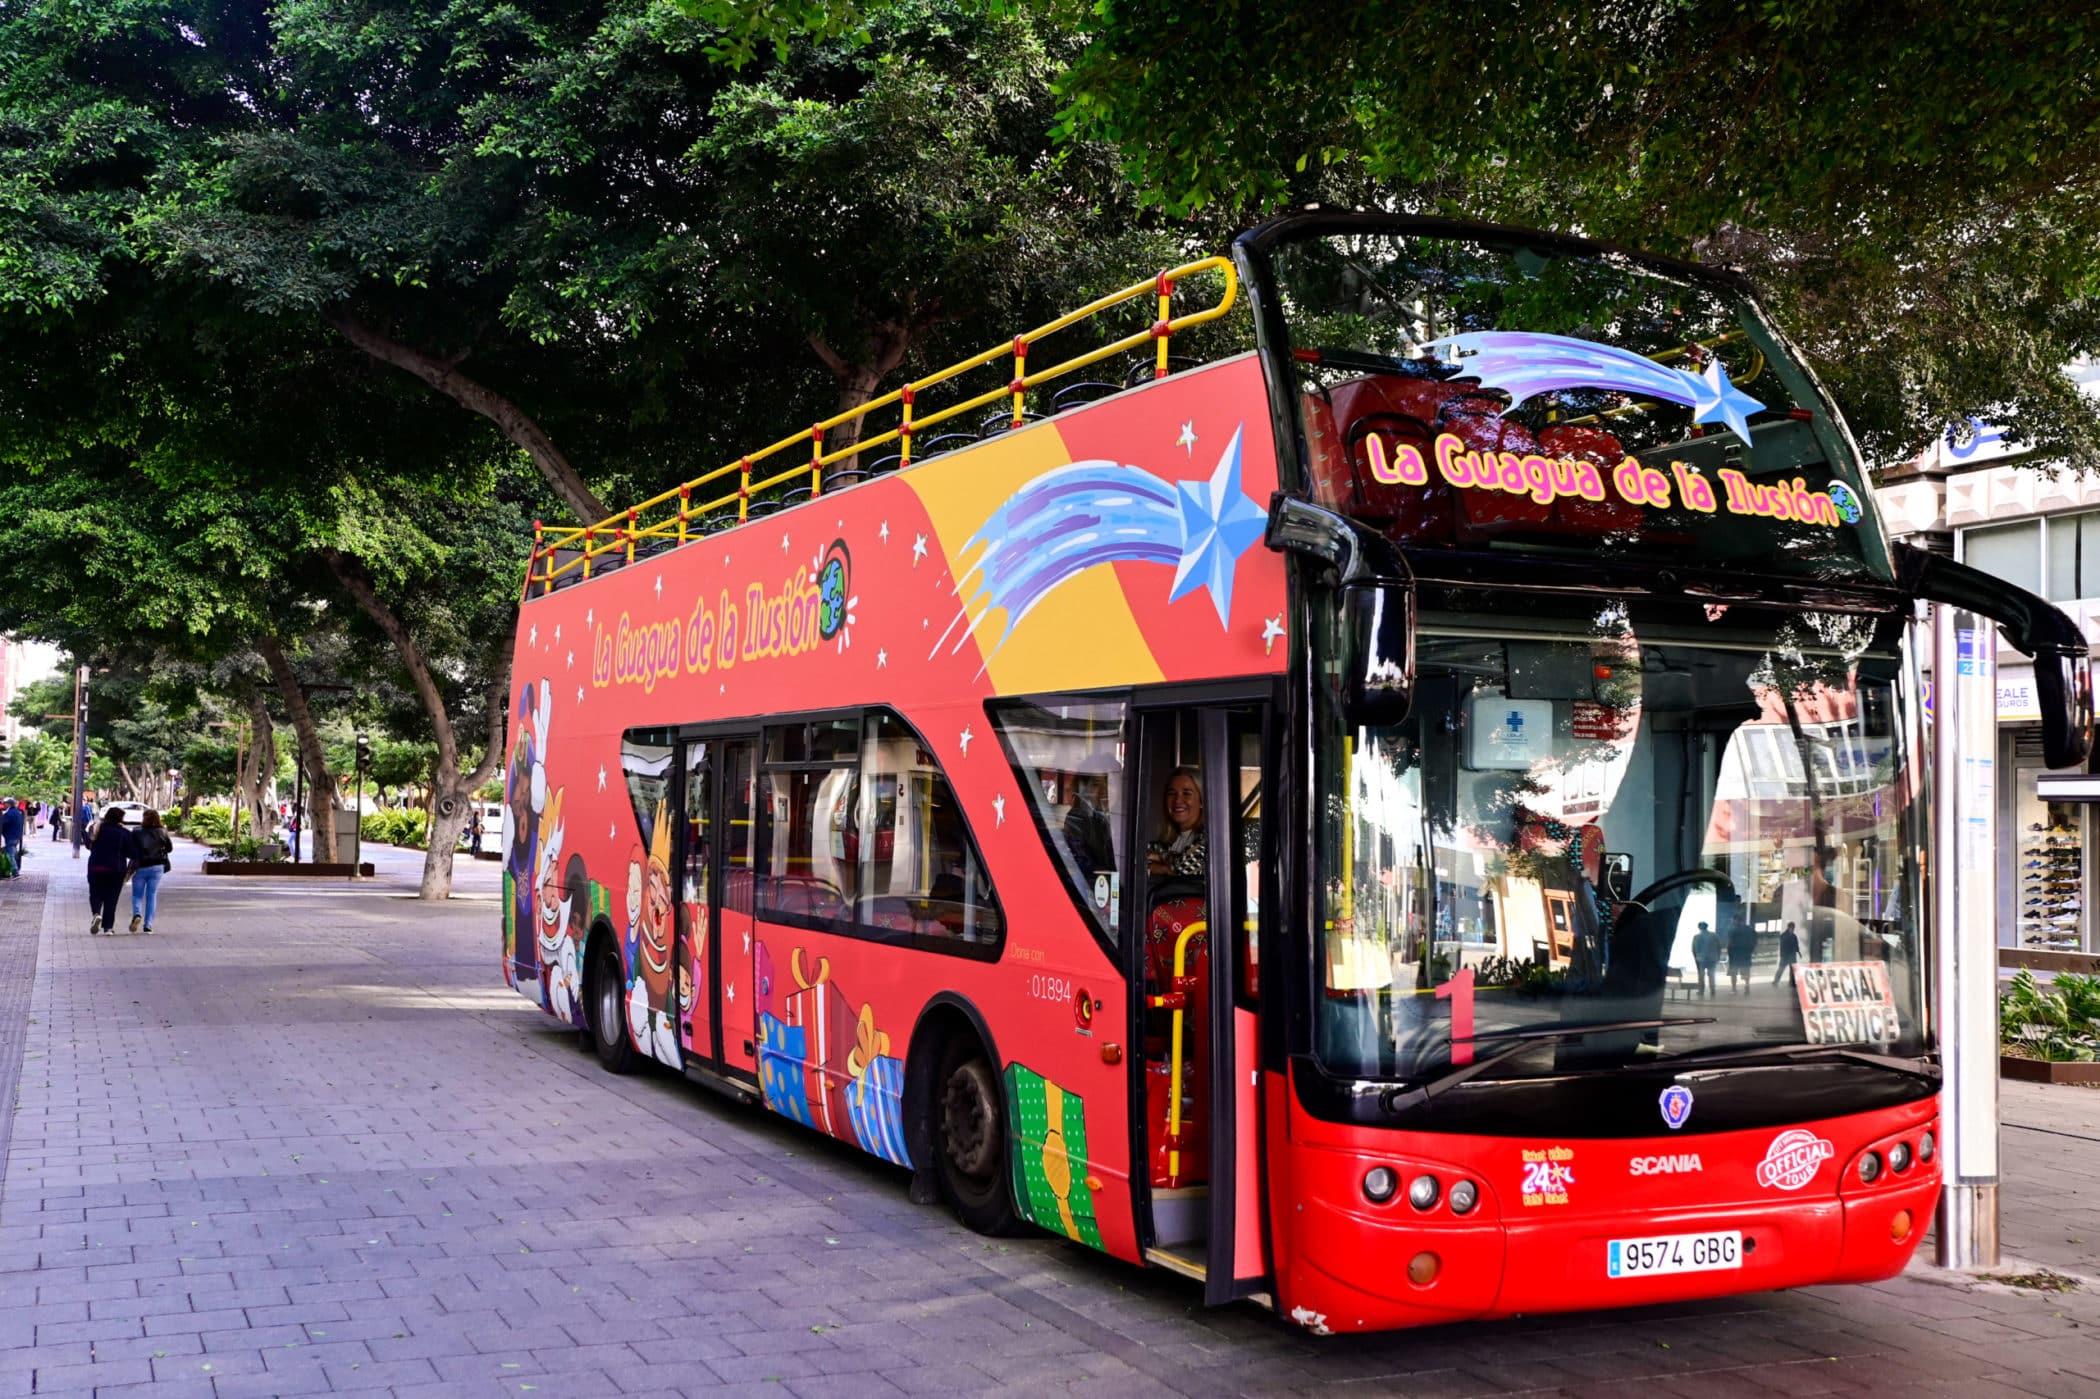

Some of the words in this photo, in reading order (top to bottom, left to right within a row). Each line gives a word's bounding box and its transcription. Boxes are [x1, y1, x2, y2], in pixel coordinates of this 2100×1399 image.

[1366, 433, 1428, 486] La
[1435, 433, 1605, 504] Guagua
[1613, 456, 1671, 509] de
[1671, 461, 1717, 513] la
[1718, 468, 1839, 528] Ilusión
[593, 622, 612, 688] La
[616, 611, 681, 695] Guagua
[686, 596, 714, 674] de
[717, 588, 738, 669] la
[742, 564, 821, 661] Ilusión
[1997, 687, 2029, 699] EALE
[1997, 699, 2029, 708] GUROS
[1804, 967, 1883, 1004] SPECIAL
[1435, 967, 1475, 1065] 1
[1807, 1007, 1898, 1045] SERVICE
[1522, 1162, 1551, 1194] 24
[1629, 1153, 1703, 1176] SCANIA
[1765, 1142, 1830, 1180] OFFICIAL
[1784, 1165, 1816, 1185] TOUR
[1626, 1239, 1684, 1270] 9574
[1693, 1236, 1735, 1265] GBG
